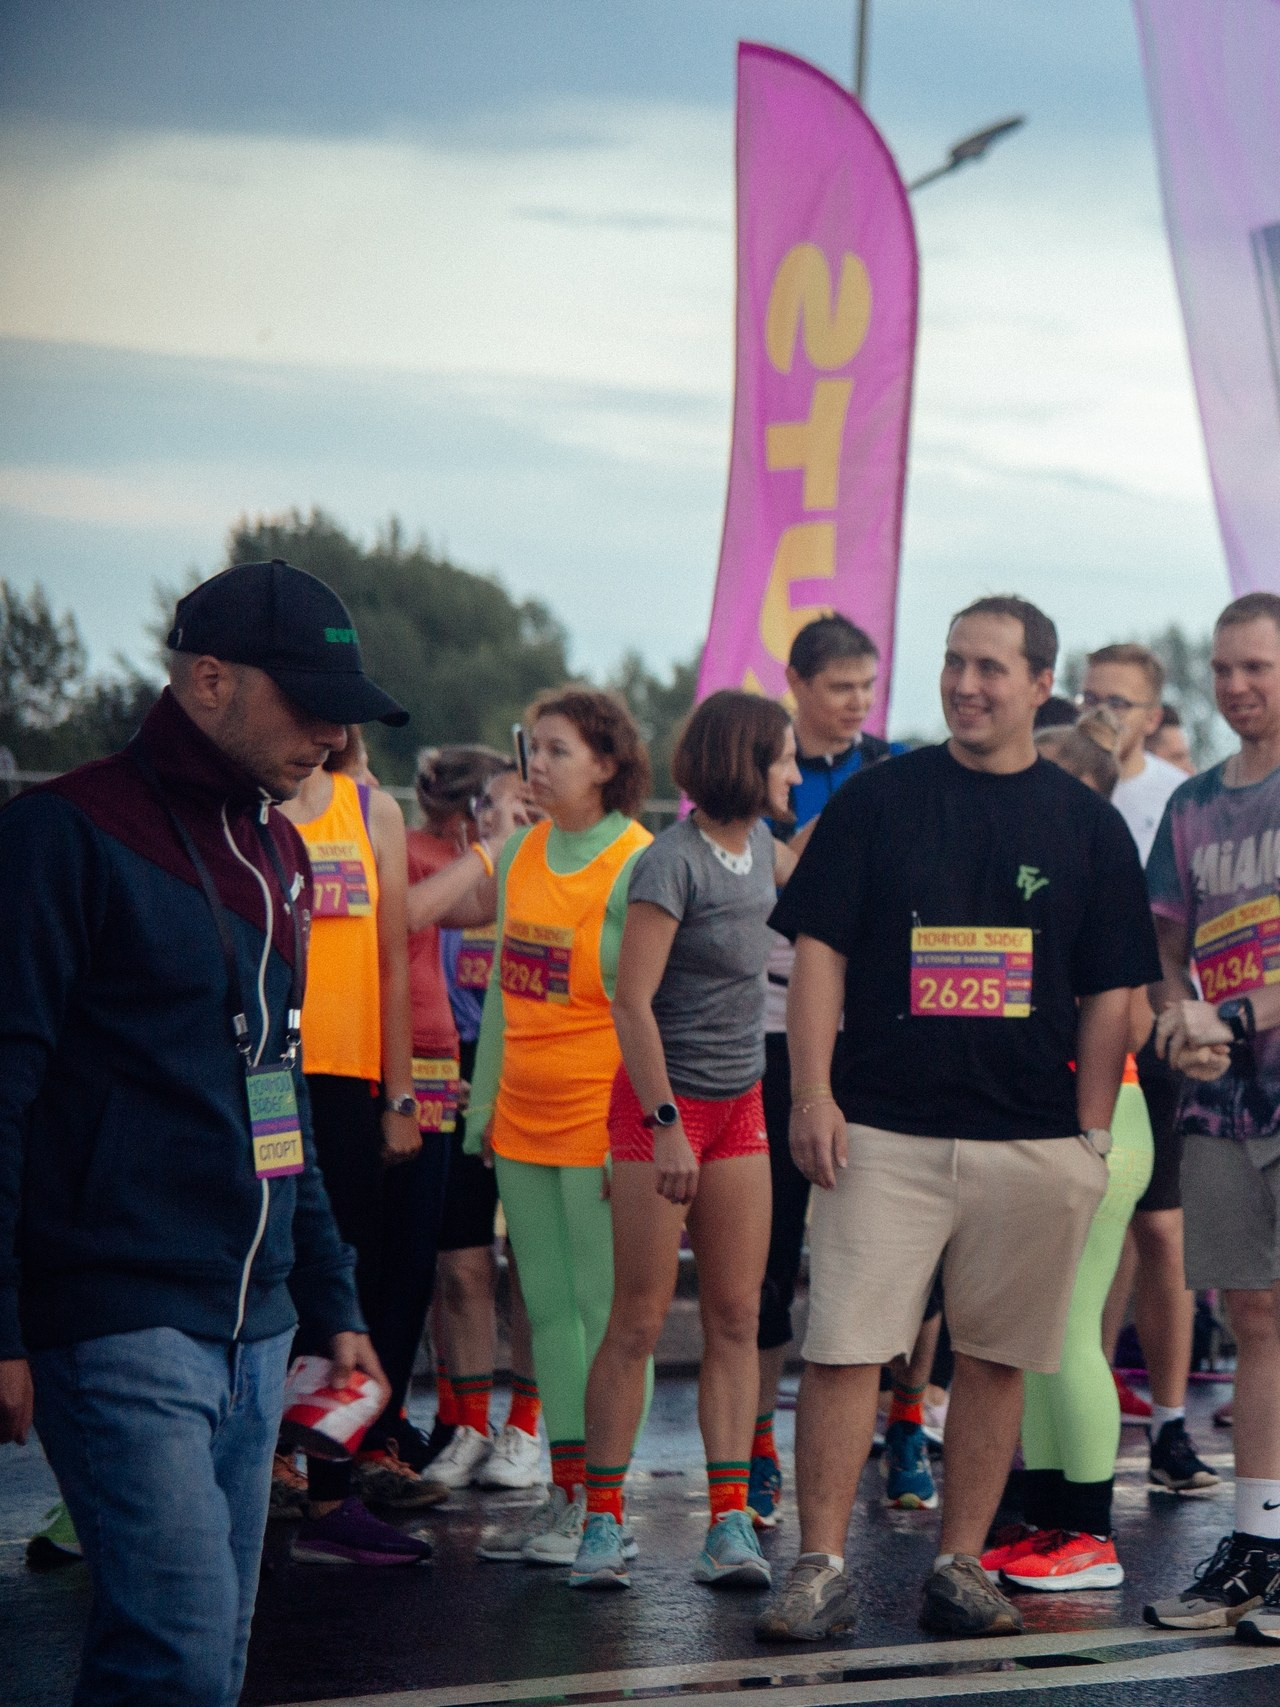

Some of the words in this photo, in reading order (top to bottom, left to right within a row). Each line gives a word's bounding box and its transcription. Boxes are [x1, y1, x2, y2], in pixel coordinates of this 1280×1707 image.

[983, 932, 1028, 947] ЗАБЕГ
[1202, 951, 1260, 999] 2434
[918, 977, 1000, 1010] 2625
[259, 1140, 297, 1161] СПОРТ
